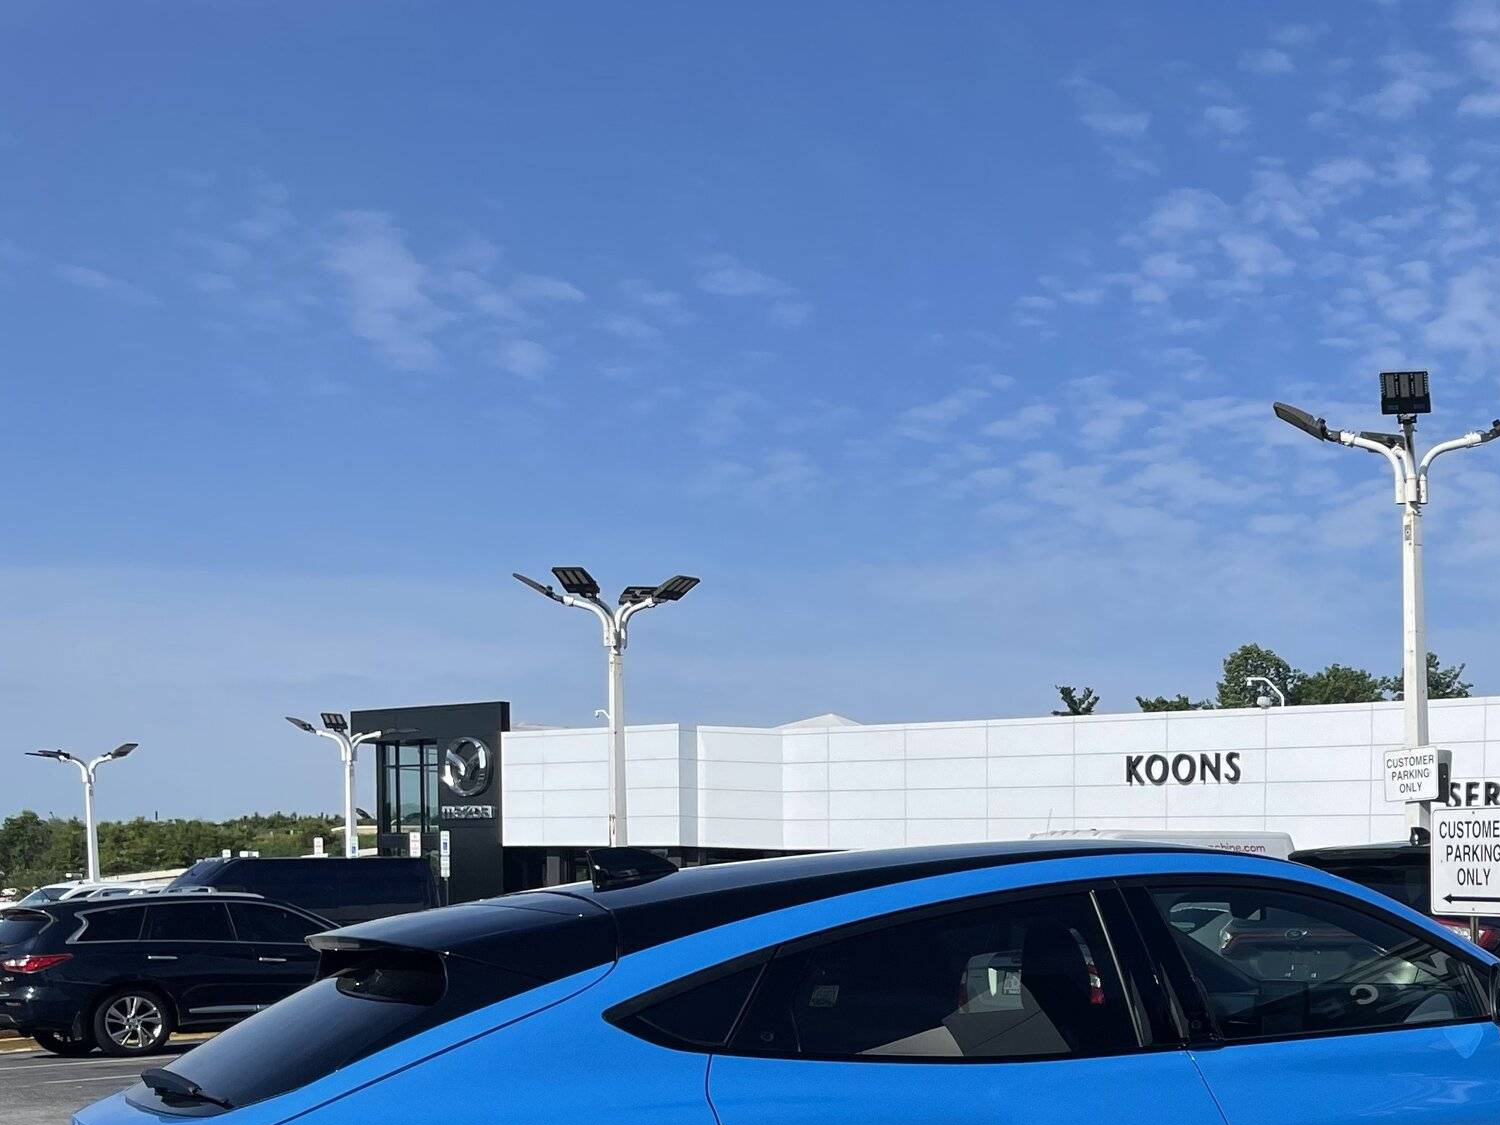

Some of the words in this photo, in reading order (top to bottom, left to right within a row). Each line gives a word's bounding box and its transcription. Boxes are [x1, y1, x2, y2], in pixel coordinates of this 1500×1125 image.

[1126, 752, 1241, 786] KOONS
[1386, 754, 1435, 769] CUSTOMER
[1391, 768, 1430, 781] PARKING
[1399, 782, 1423, 793] ONLY
[1457, 868, 1491, 886] ONLY
